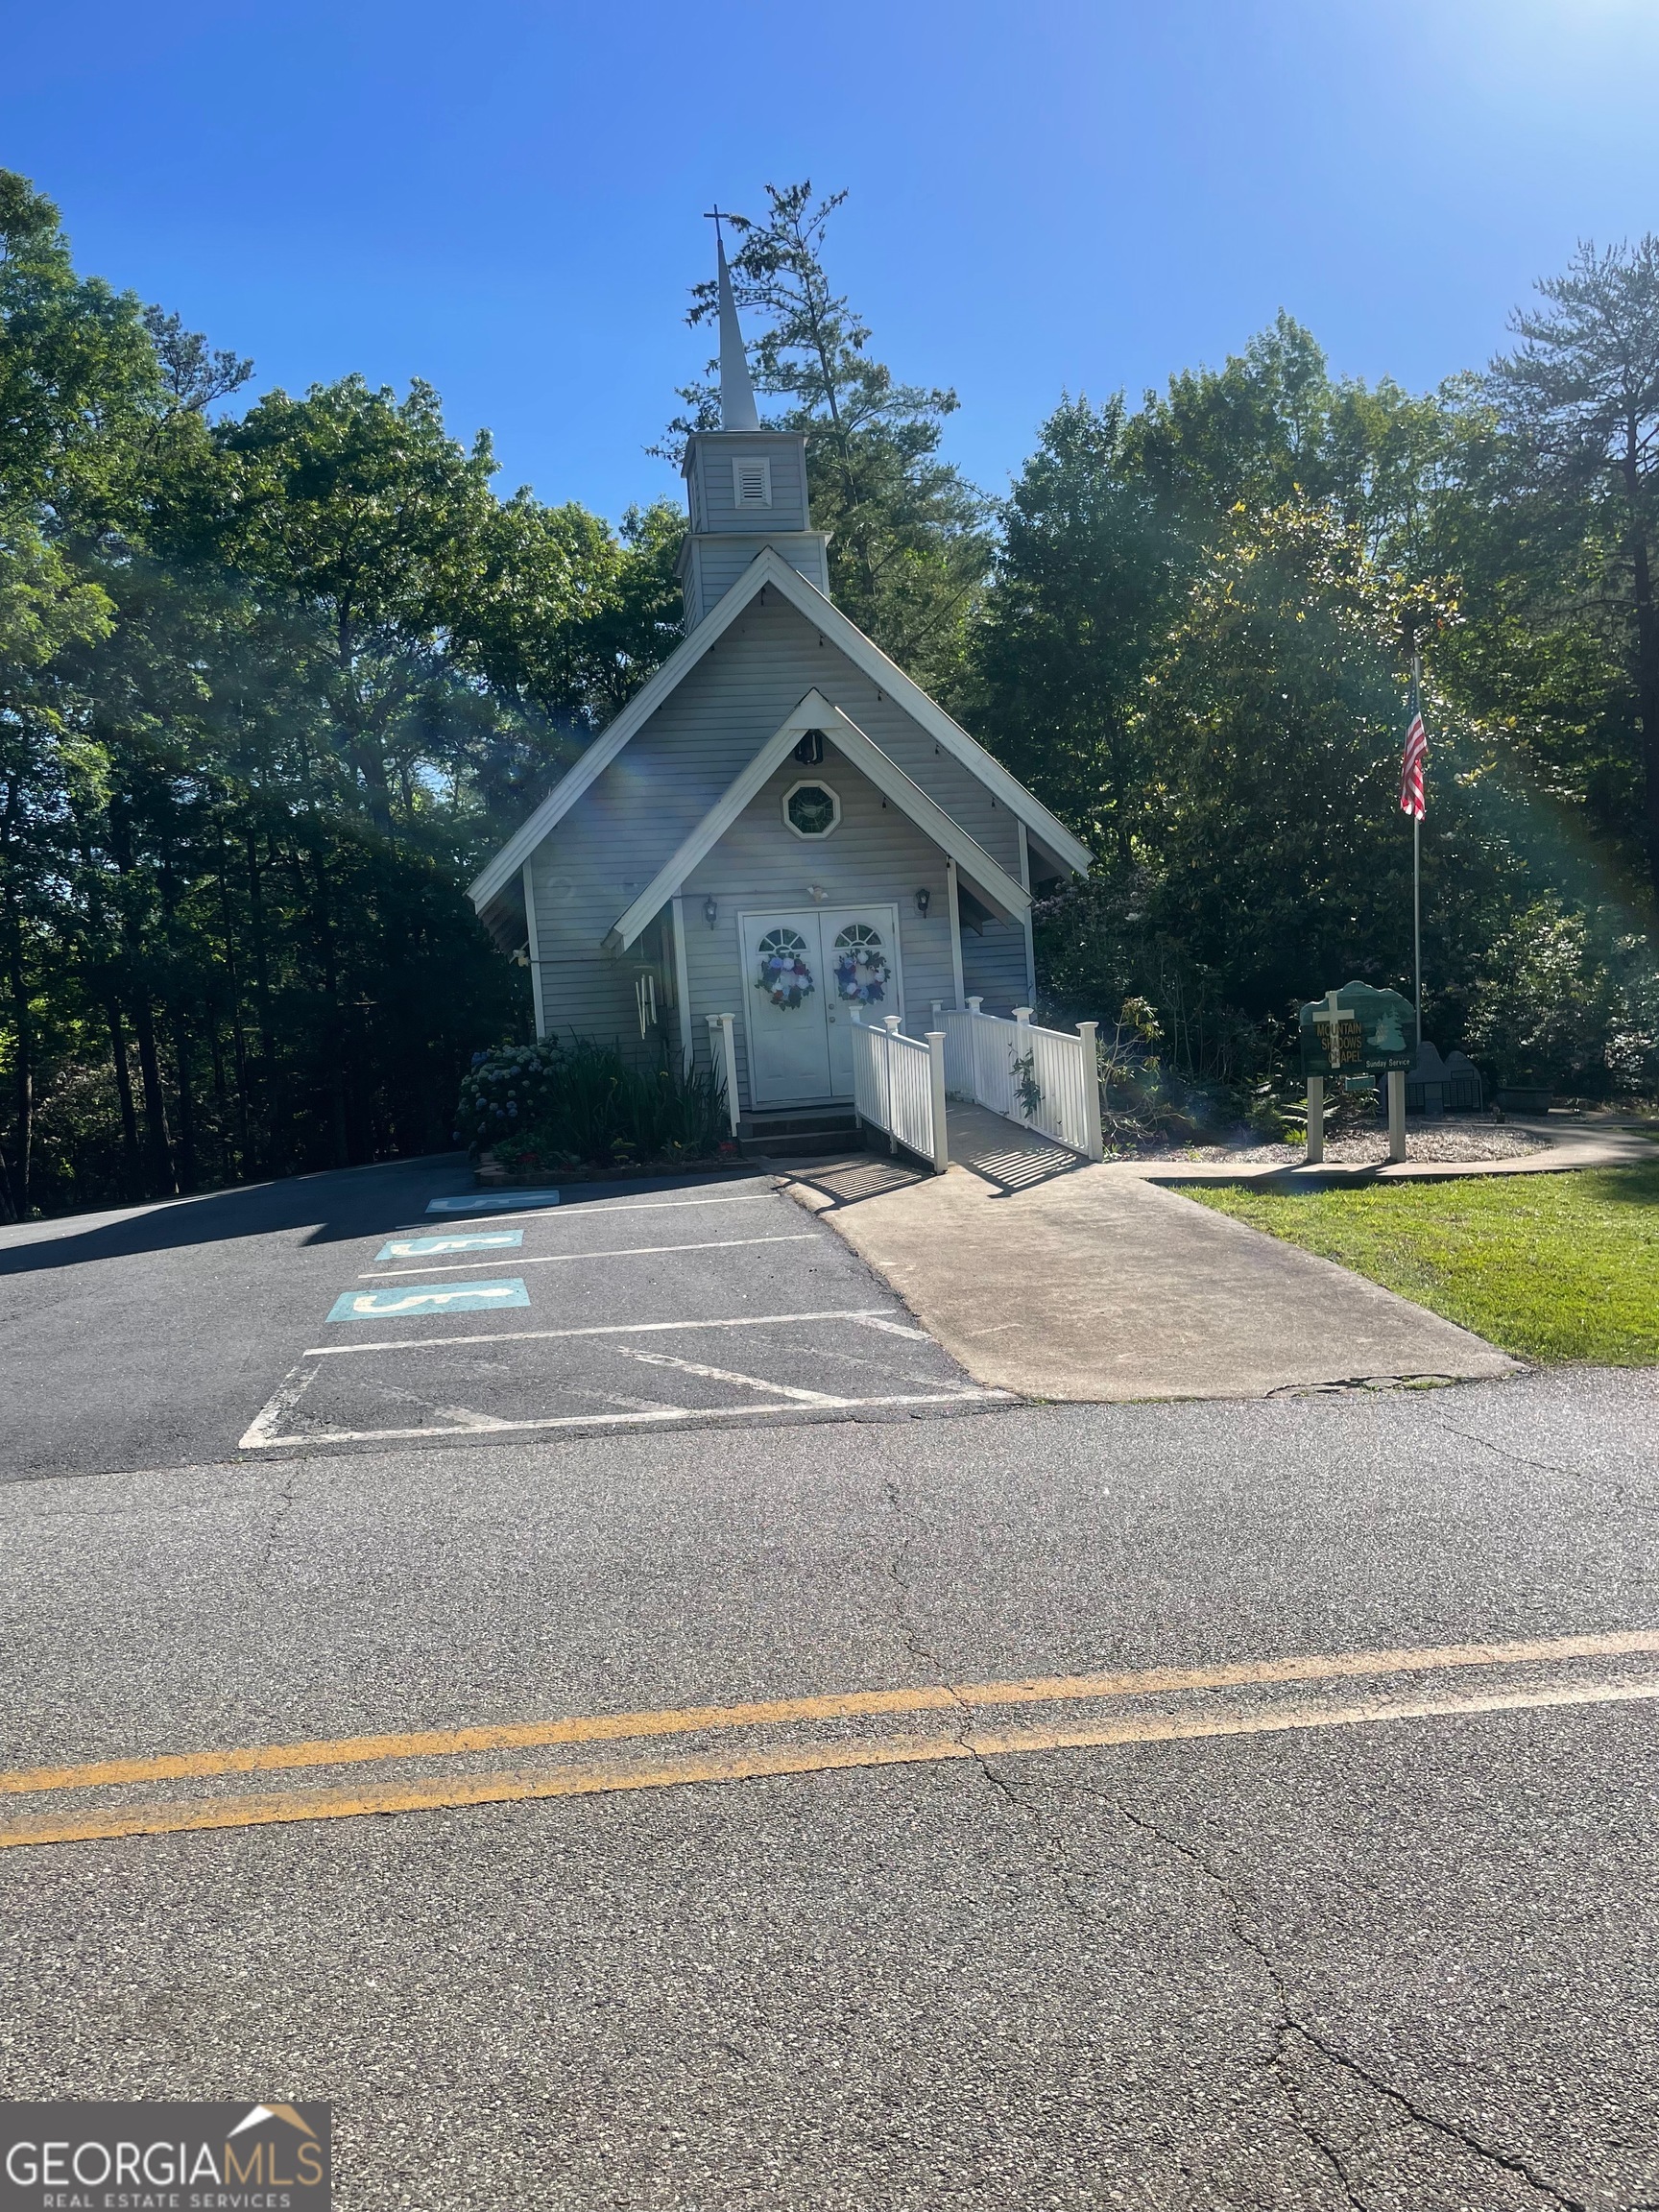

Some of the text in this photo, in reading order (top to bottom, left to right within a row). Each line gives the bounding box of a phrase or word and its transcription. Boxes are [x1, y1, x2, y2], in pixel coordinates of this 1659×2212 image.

[1317, 1022, 1361, 1037] MOUNTAIN
[1321, 1037, 1362, 1050] SHADOWS
[1328, 1050, 1362, 1064] CHAPEL
[1365, 1058, 1410, 1069] Sunday Service
